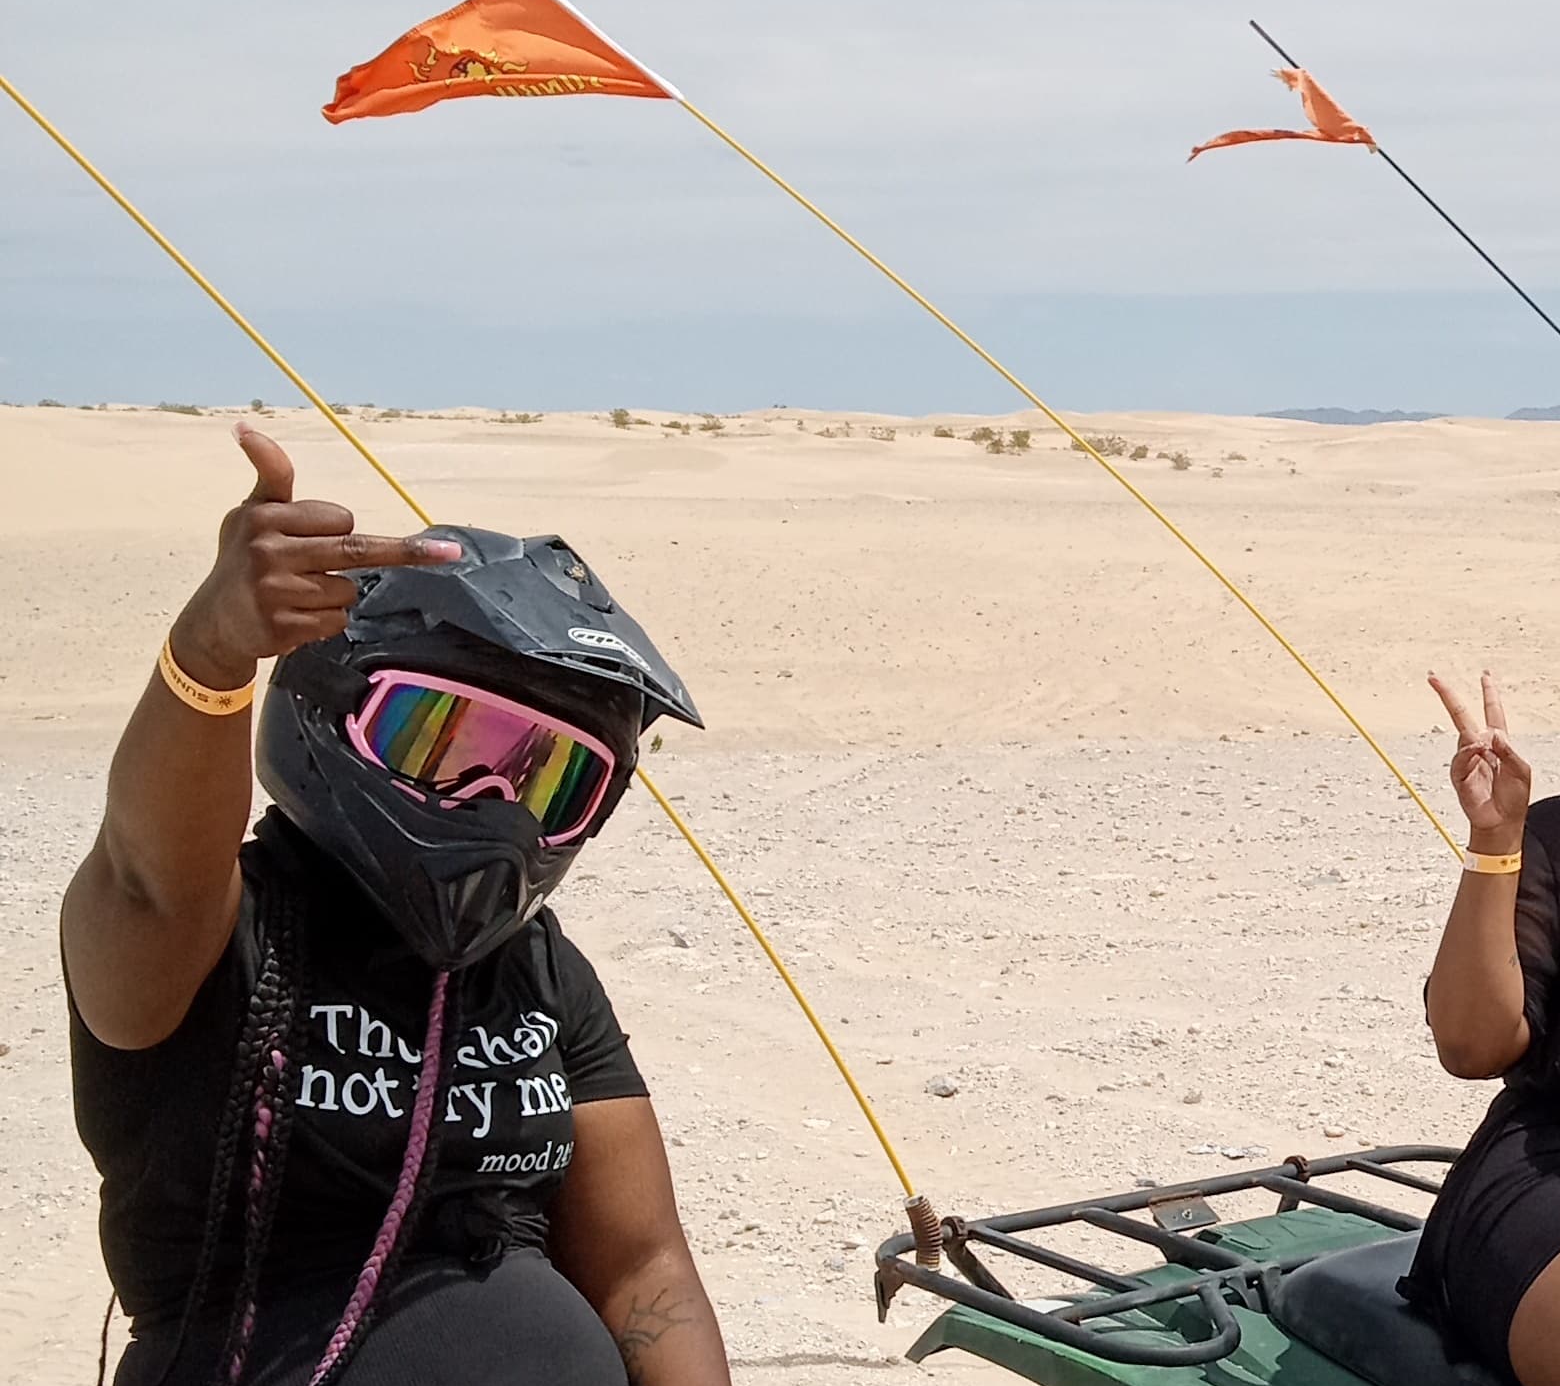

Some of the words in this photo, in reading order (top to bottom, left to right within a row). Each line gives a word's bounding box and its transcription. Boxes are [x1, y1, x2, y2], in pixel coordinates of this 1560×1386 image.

[295, 1064, 404, 1119] not
[412, 1074, 496, 1139] ry
[477, 1140, 553, 1172] mood
